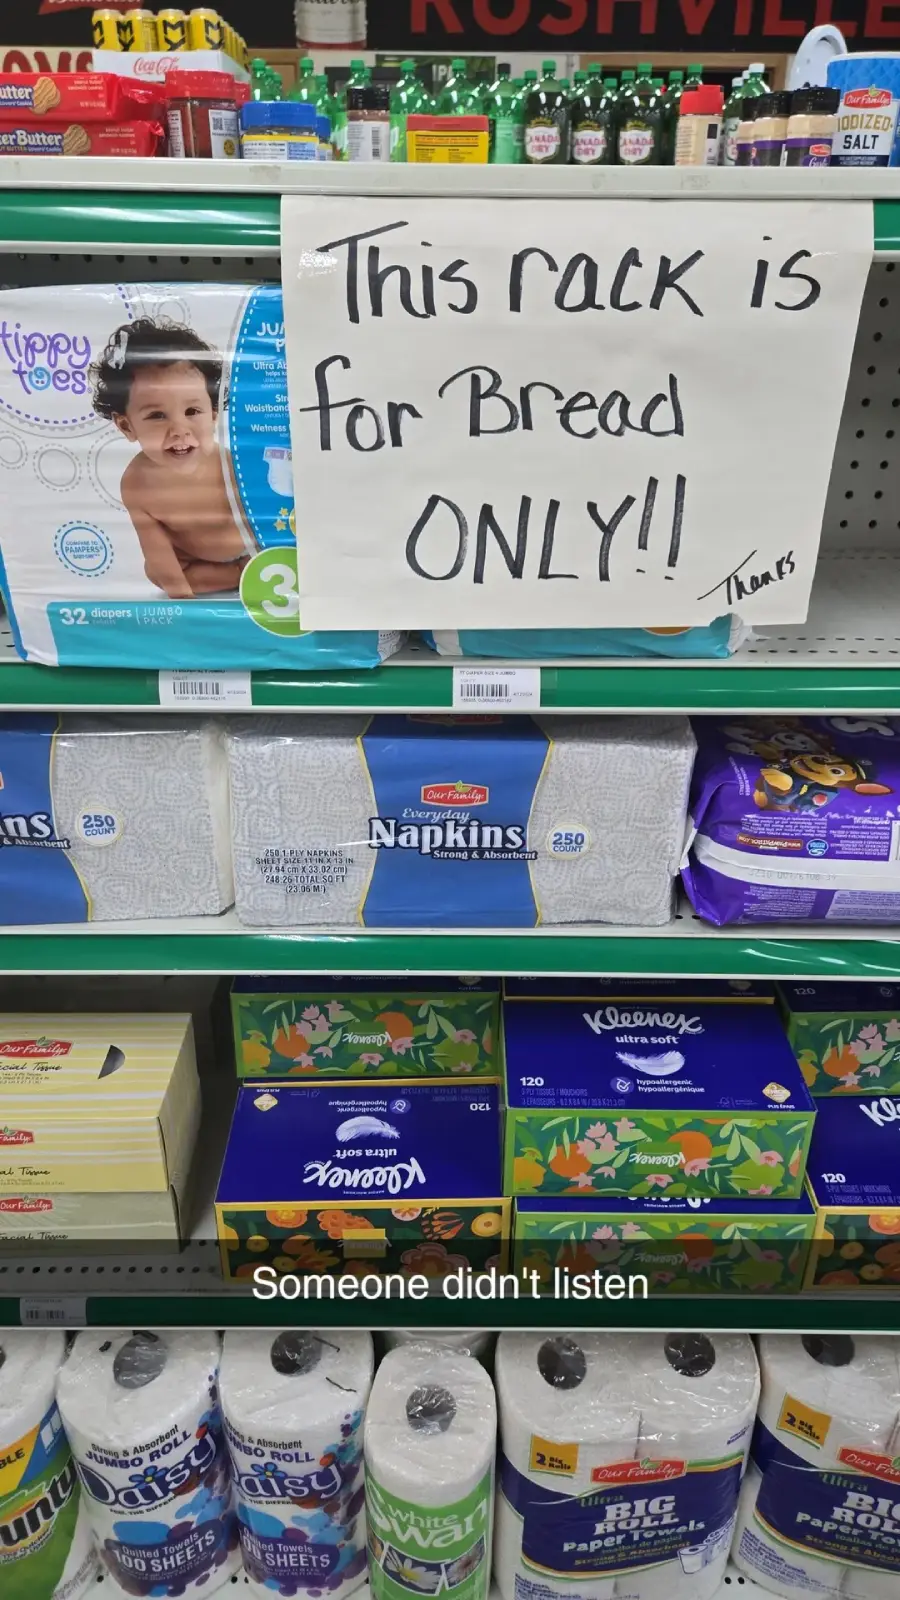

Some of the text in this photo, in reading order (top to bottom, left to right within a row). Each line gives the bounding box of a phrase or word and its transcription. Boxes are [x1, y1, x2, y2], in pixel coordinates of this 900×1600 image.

[843, 134, 880, 150] SALT
[317, 221, 822, 323] This rack is
[0, 320, 92, 369] tippy
[253, 361, 275, 370] Ultra
[12, 361, 88, 395] toes
[299, 354, 685, 452] for Bread
[251, 424, 287, 433] Wetness
[405, 473, 687, 584] ONLY!!
[696, 548, 796, 605] Thanks
[260, 562, 298, 618] 3
[60, 607, 90, 625] 32
[91, 607, 132, 619] diapers
[143, 605, 183, 617] JUMBO
[144, 617, 174, 626] PACK
[426, 790, 482, 804] Our Family
[82, 814, 116, 828] 250
[402, 807, 471, 822] Everyday
[84, 827, 117, 837] COUNT
[369, 818, 525, 854] Napkins
[552, 832, 585, 846] 250
[265, 849, 280, 857] 250
[433, 850, 538, 860] Strong & Absorbent
[553, 844, 584, 853] COUNT
[256, 857, 281, 865] SHEET
[301, 865, 307, 873] X
[265, 875, 293, 884] 248.26
[295, 875, 320, 883] TOTAL
[335, 875, 346, 883] FT
[285, 884, 311, 894] (23.06
[582, 1006, 703, 1035] Kleenex
[342, 1030, 393, 1048] Kleenex
[615, 1034, 680, 1044] ultra soft
[32, 1061, 62, 1072] Tissue
[519, 1076, 545, 1086] 120
[636, 1078, 693, 1087] hypoallergenic
[638, 1085, 706, 1093] hypoallergénique
[469, 1102, 491, 1112] 120
[335, 1148, 397, 1159] ultra soft
[629, 1151, 686, 1168] Kleenex
[18, 1166, 51, 1176] Tissue
[302, 1156, 426, 1195] Kleenex
[821, 1172, 847, 1184] 120
[0, 1201, 17, 1210] Our
[37, 1231, 69, 1241] Tissue
[784, 1412, 797, 1426] 2
[91, 1424, 180, 1459] Strong & Absorbent
[256, 1438, 303, 1450] Absorbent
[85, 1430, 192, 1469] JUMBO ROLL
[269, 1450, 316, 1463] ROLL
[535, 1452, 547, 1466] 2
[844, 1453, 875, 1468] Our
[78, 1430, 217, 1508] Daisy
[598, 1464, 679, 1479] Our Family
[387, 1503, 459, 1528] white
[603, 1495, 676, 1522] BIG
[592, 1513, 680, 1536] ROLL
[796, 1511, 864, 1536] Paper
[563, 1519, 706, 1553] Paper Towels
[805, 1533, 849, 1550] Strong
[113, 1549, 147, 1572] 100
[151, 1529, 216, 1572] SHEETS
[122, 1544, 160, 1559] Quilted
[277, 1543, 313, 1554] Towels
[266, 1552, 331, 1568] SHEETS
